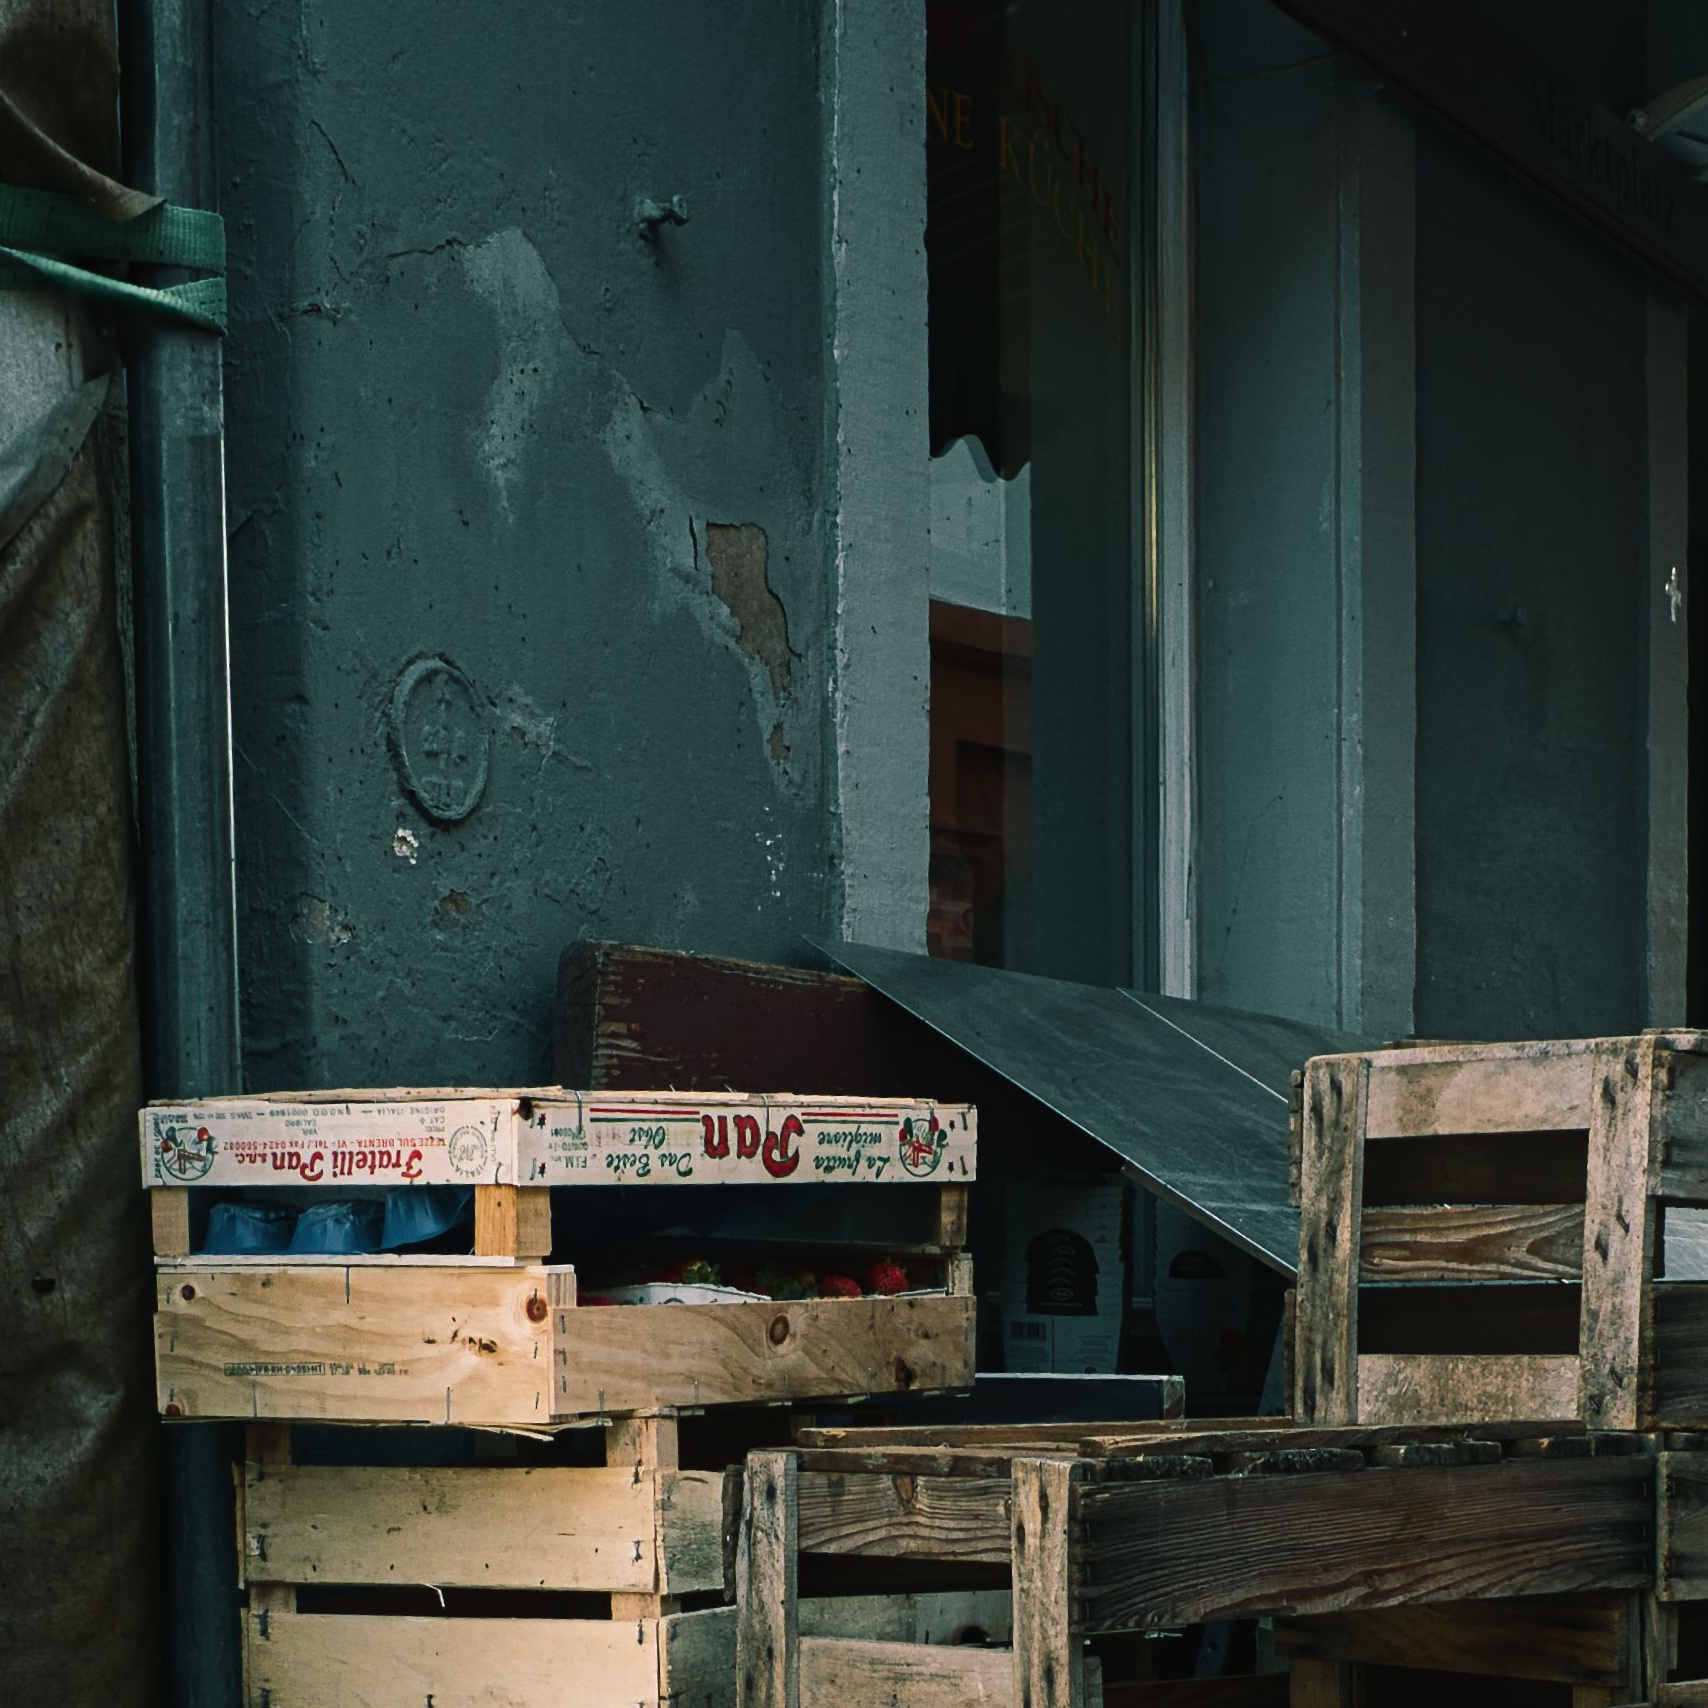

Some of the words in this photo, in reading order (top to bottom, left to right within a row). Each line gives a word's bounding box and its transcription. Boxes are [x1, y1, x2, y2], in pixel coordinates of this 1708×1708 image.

[356, 1139, 395, 1149] BRENTA
[398, 1137, 417, 1148] SUL
[629, 1125, 666, 1150] Obst
[701, 1114, 806, 1179] Pan
[817, 1125, 882, 1151] migliore
[271, 1151, 325, 1182] Pan
[332, 1149, 423, 1180] Fratelli
[455, 1164, 483, 1179] ITALIA
[605, 1152, 652, 1178] Beste
[658, 1152, 693, 1178] Das
[813, 1150, 862, 1177] frutta
[866, 1155, 890, 1181] La
